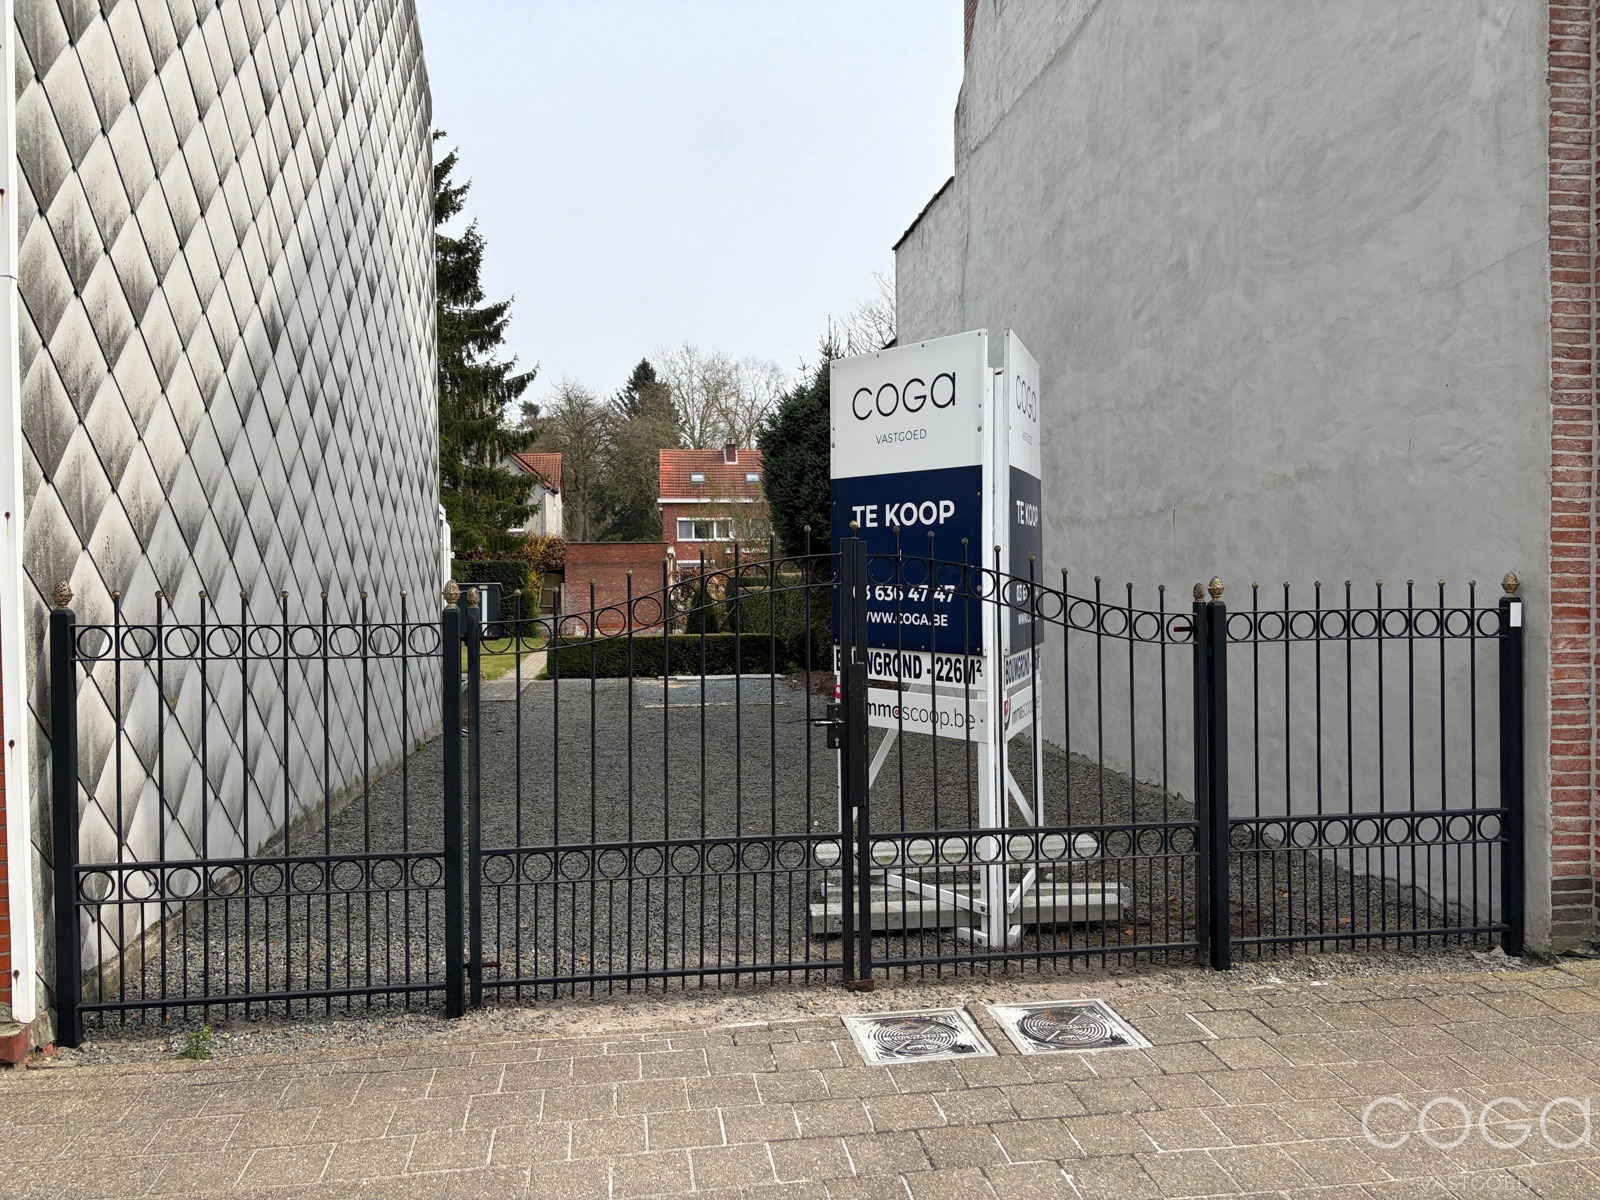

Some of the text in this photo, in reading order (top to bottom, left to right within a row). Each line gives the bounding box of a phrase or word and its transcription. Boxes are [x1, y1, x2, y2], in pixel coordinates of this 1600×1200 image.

[875, 428, 927, 445] VASTGOED
[852, 500, 955, 528] TE KOOP
[1016, 499, 1039, 528] TE KOOP
[908, 584, 929, 602] 47
[934, 584, 956, 603] 47
